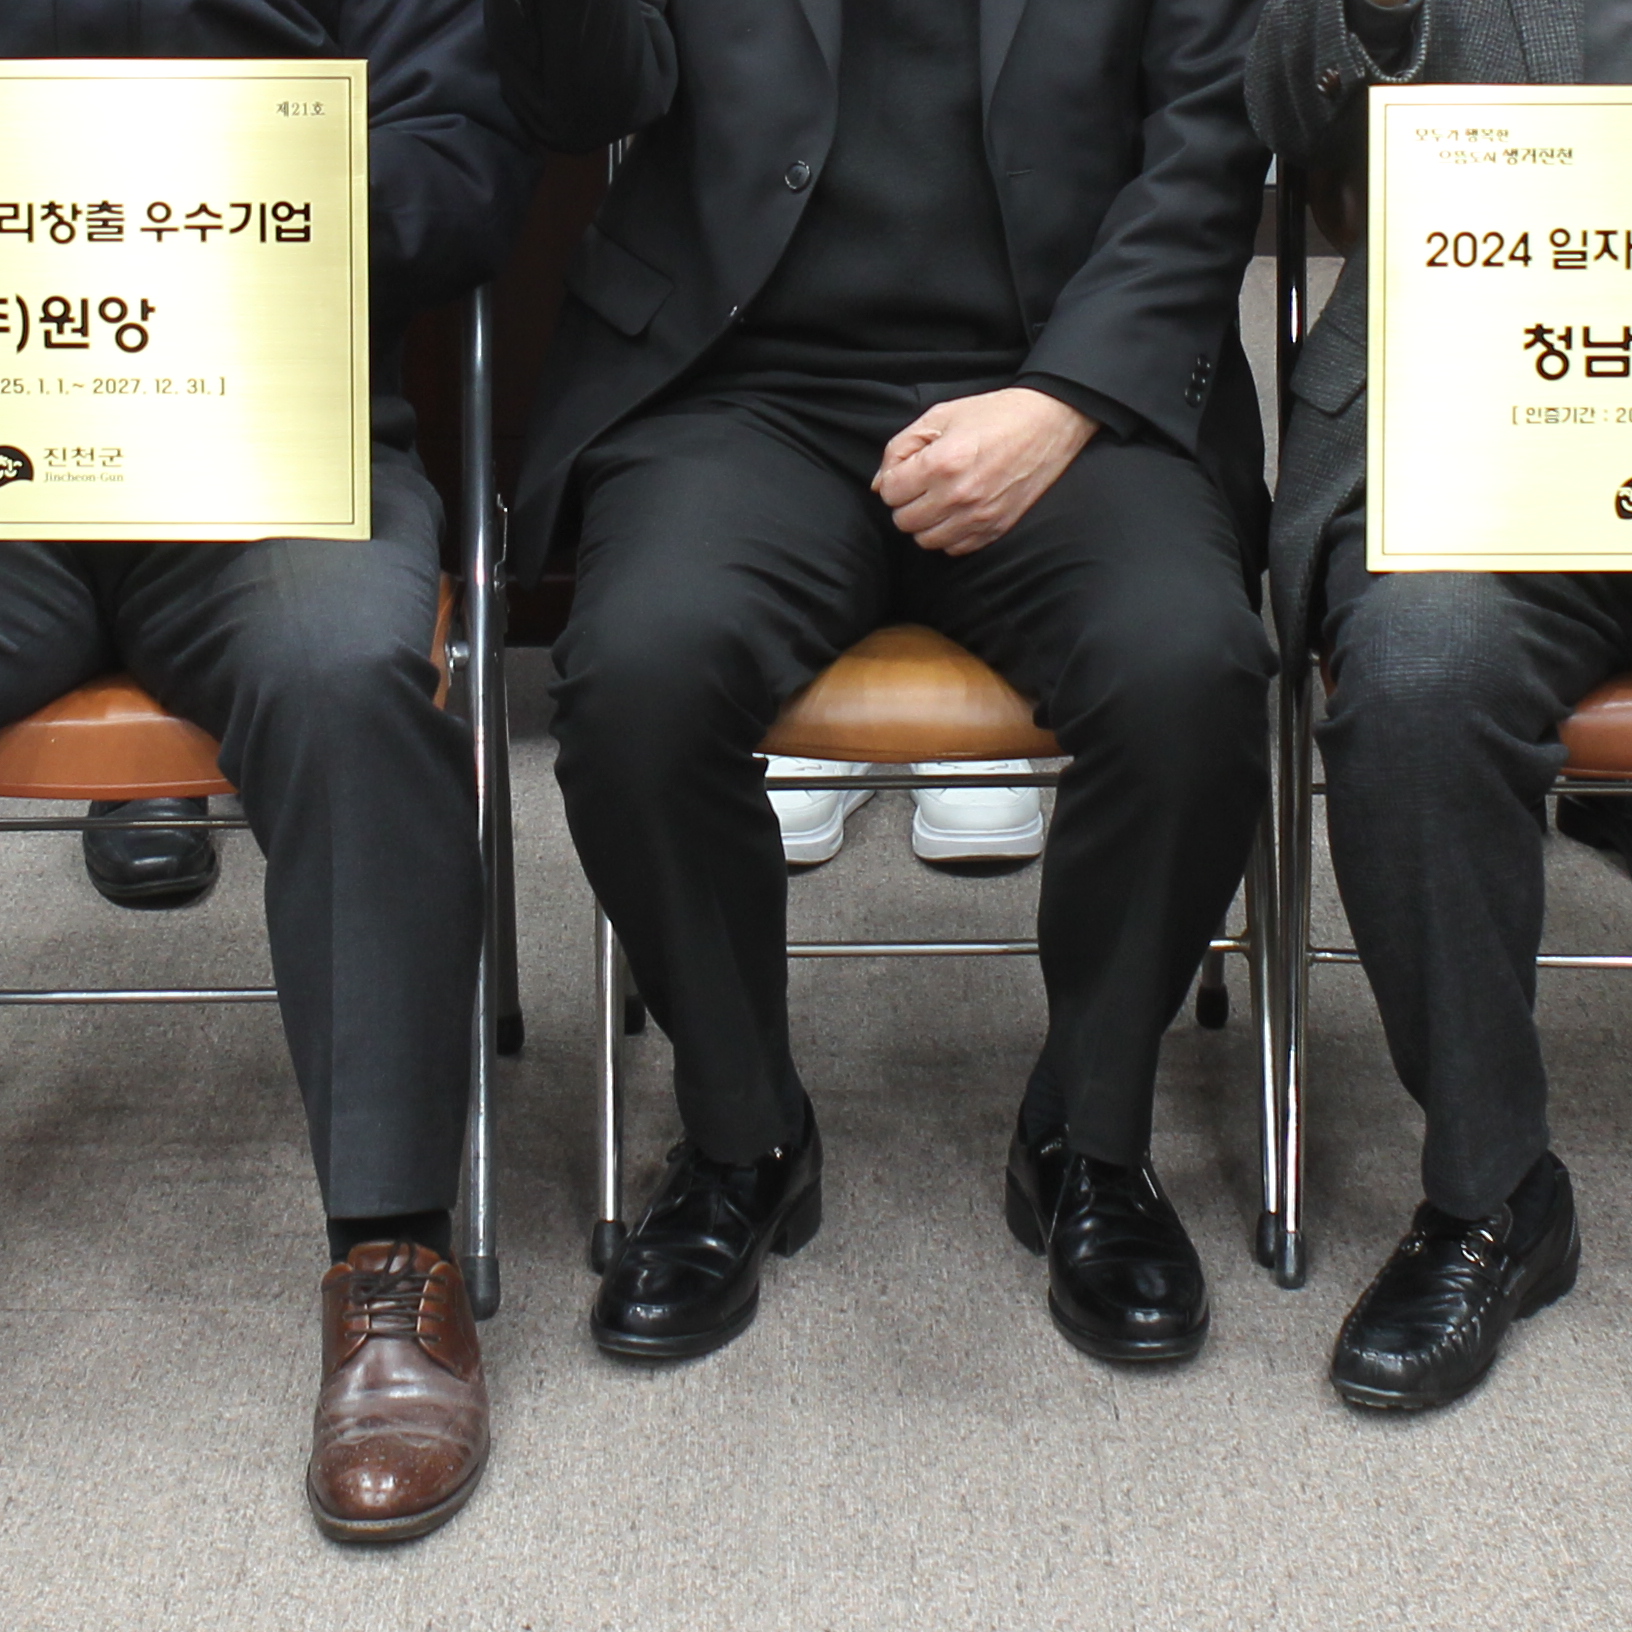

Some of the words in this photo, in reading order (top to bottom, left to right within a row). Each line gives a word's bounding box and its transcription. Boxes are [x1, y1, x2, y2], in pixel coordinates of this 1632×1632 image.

[276, 101, 327, 118] 제21호
[1415, 129, 1459, 142] 모두가
[1465, 128, 1509, 143] 행복한
[1502, 147, 1573, 166] 생거진천
[140, 200, 312, 244] 우수기업
[1426, 231, 1532, 268] 2024
[93, 378, 147, 395] 2027.
[155, 378, 179, 395] 12.
[186, 378, 211, 395] 31.
[1526, 406, 1596, 424] 인증기간
[43, 447, 124, 467] 진천군
